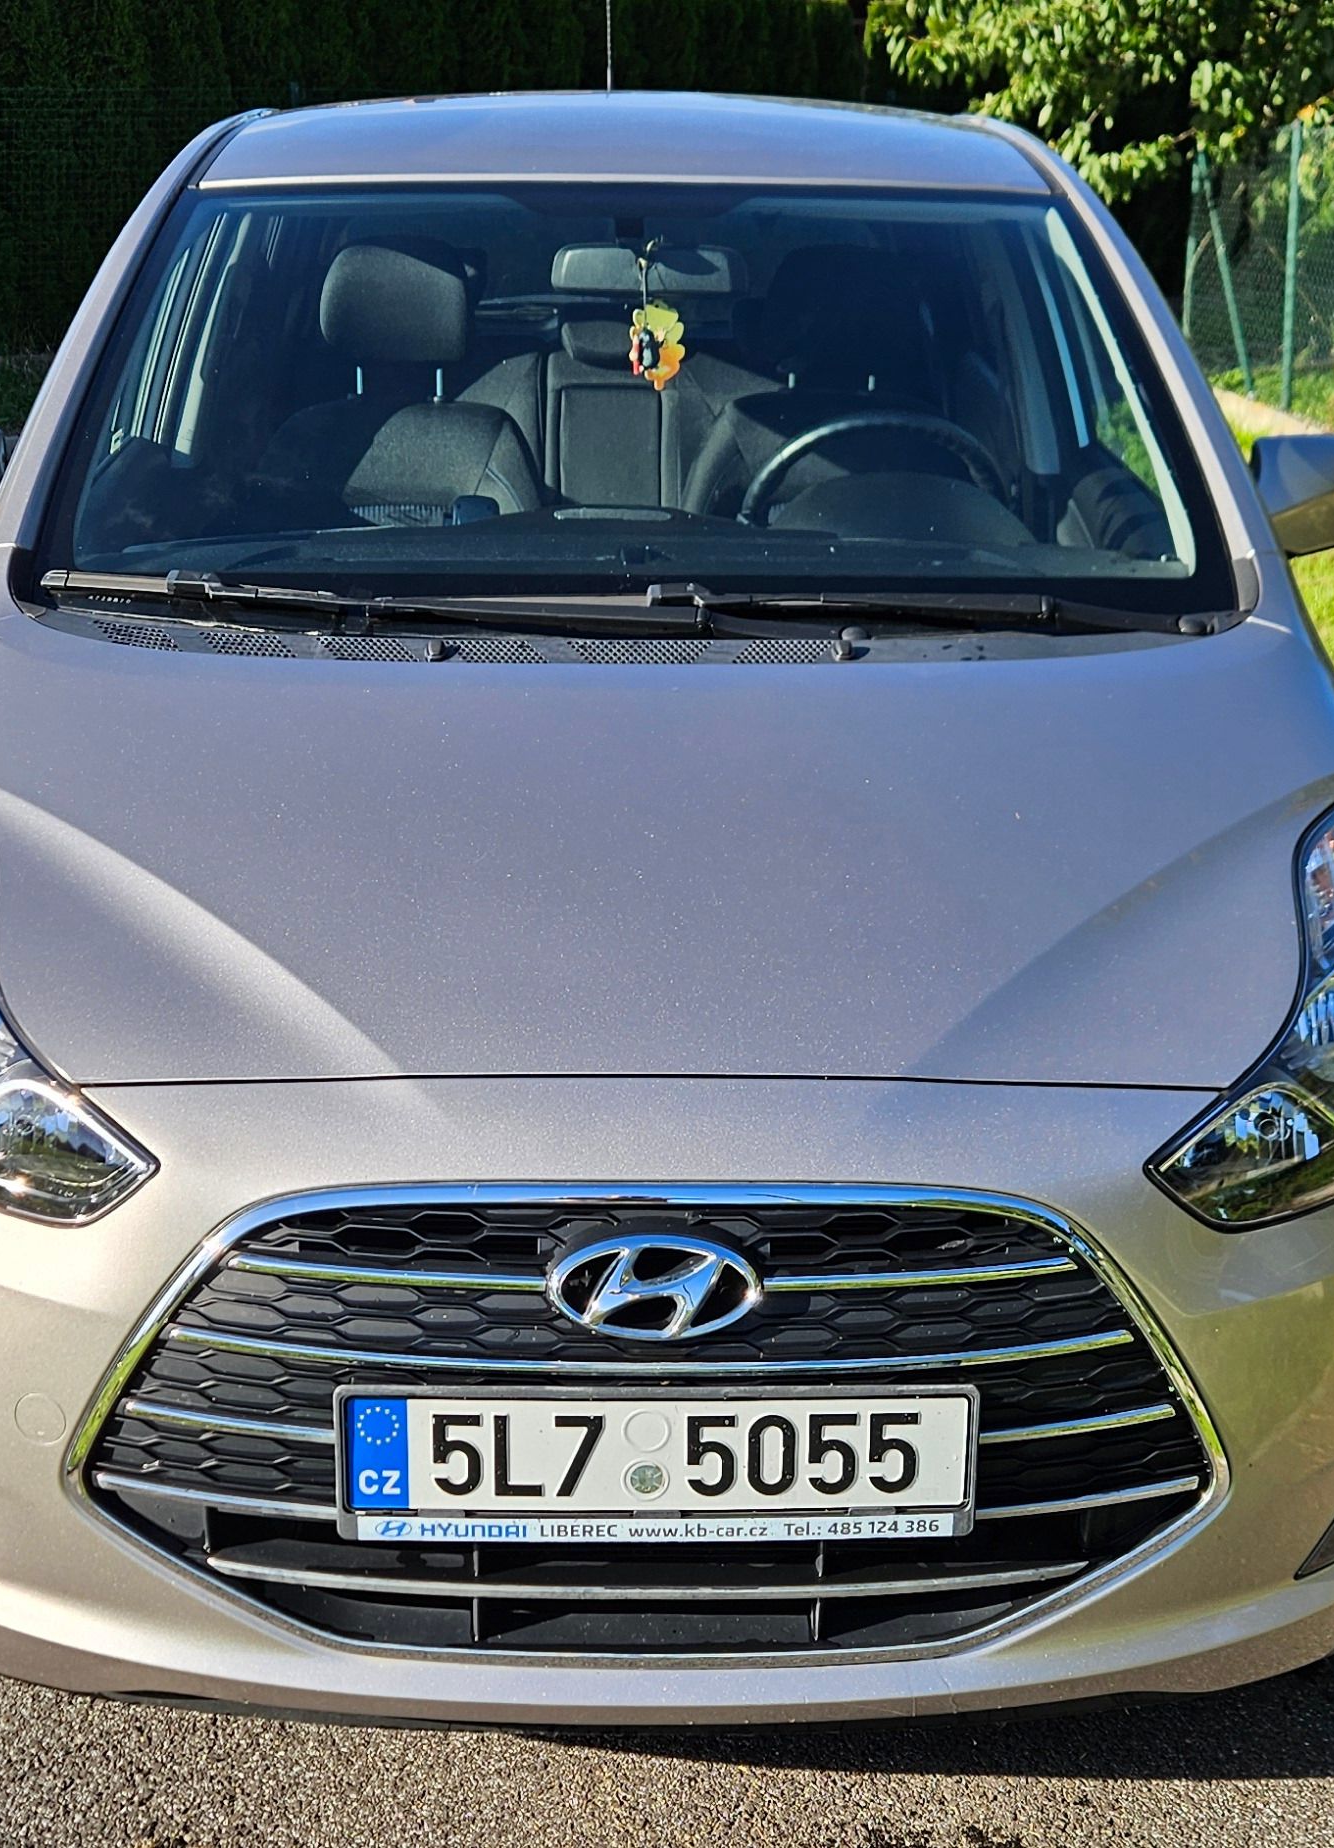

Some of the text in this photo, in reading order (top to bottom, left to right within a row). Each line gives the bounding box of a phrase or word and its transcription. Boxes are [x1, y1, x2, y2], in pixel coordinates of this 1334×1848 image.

[432, 1412, 921, 1497] 5L7 5055
[358, 1469, 401, 1495] CZ
[420, 1523, 527, 1538] HYUNDAI
[540, 1524, 618, 1538] LIBEREC
[629, 1522, 768, 1538] www.kb-car.cz
[784, 1522, 821, 1536] Tel.:
[828, 1520, 862, 1535] 485
[869, 1520, 899, 1534] 124
[905, 1519, 940, 1533] 386
